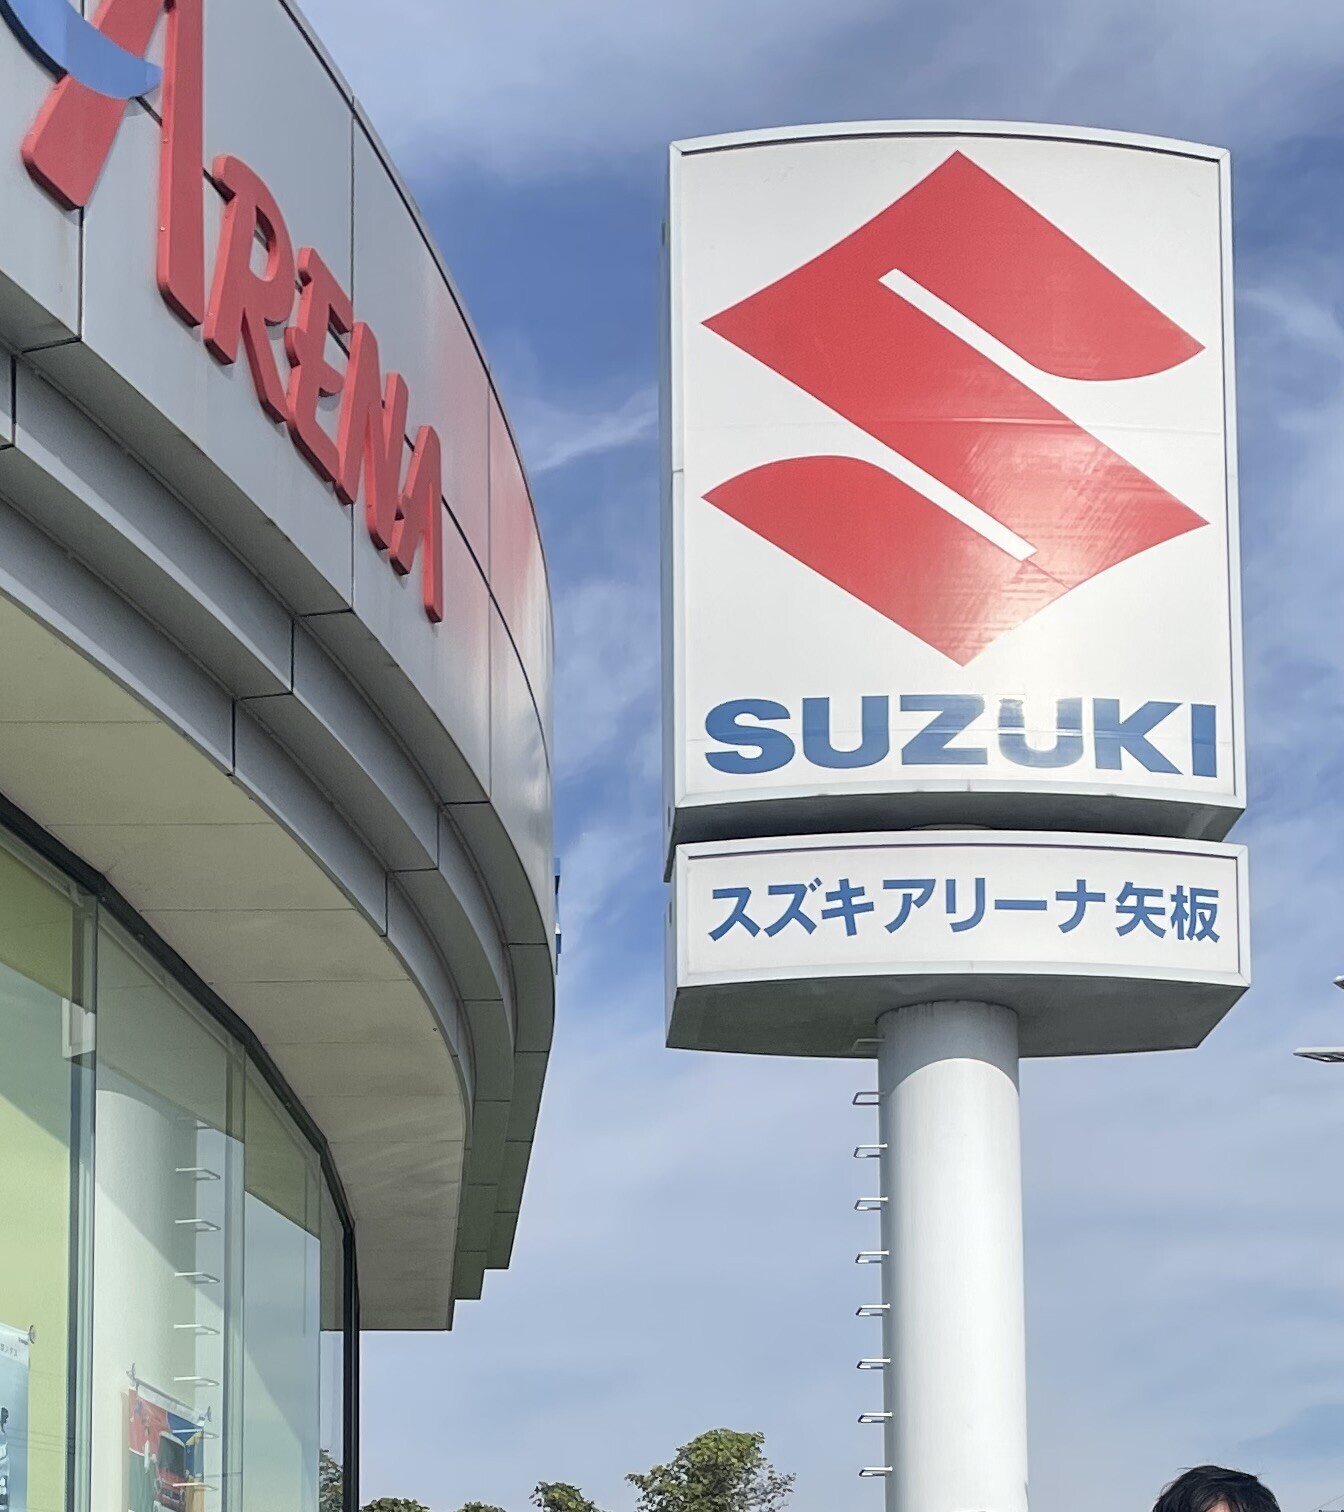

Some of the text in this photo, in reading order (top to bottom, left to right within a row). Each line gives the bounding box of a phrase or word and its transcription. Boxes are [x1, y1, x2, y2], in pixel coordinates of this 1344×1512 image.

[704, 694, 1217, 779] SUZUKI
[708, 877, 1221, 944] スズキアリーナ矢板
